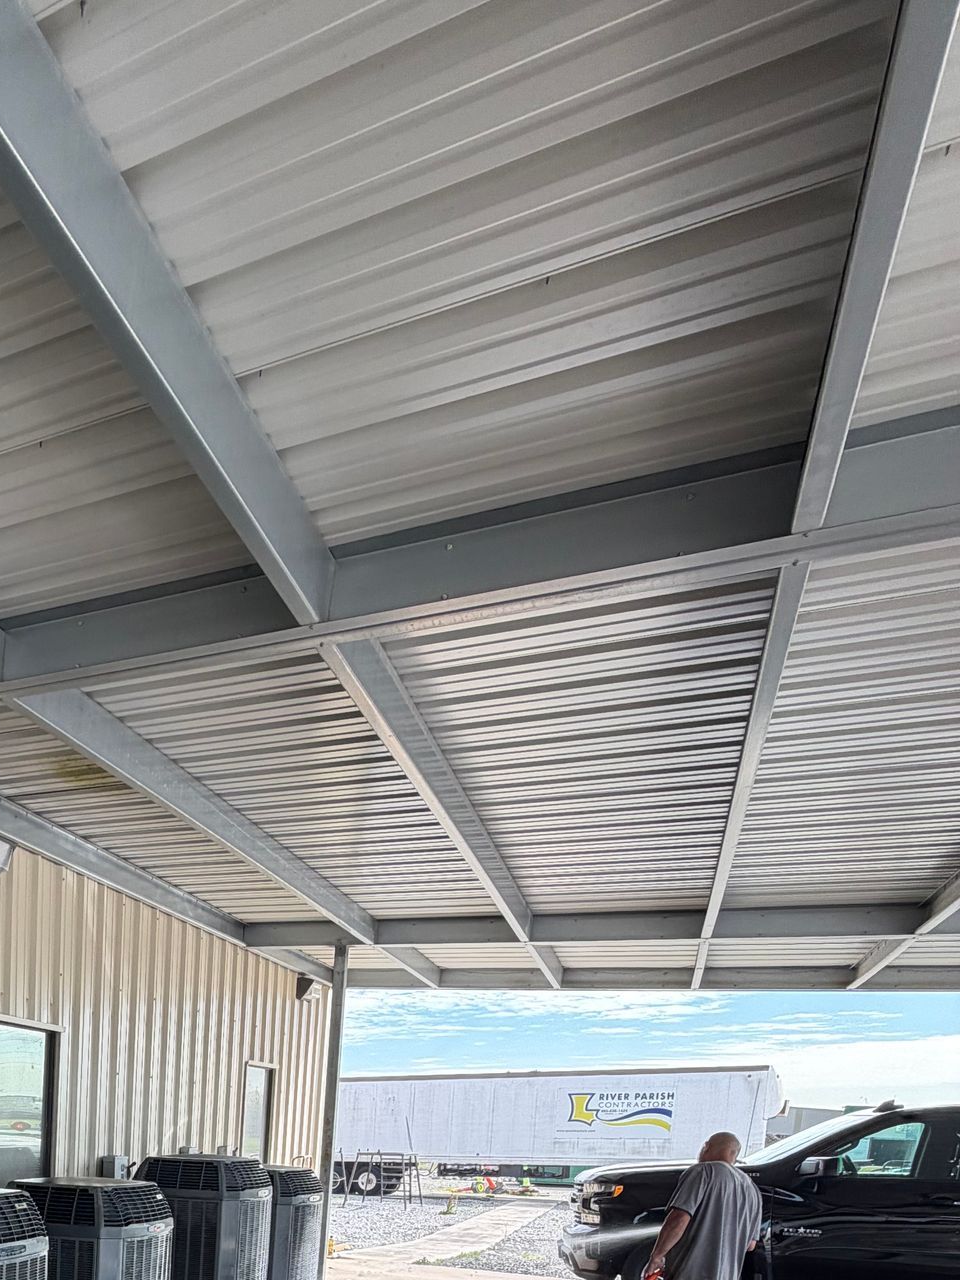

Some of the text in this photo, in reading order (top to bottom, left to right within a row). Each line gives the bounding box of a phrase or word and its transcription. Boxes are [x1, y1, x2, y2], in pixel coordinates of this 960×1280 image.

[599, 1092, 675, 1101] RIVER PARISH
[598, 1101, 674, 1109] CONTRACTORS
